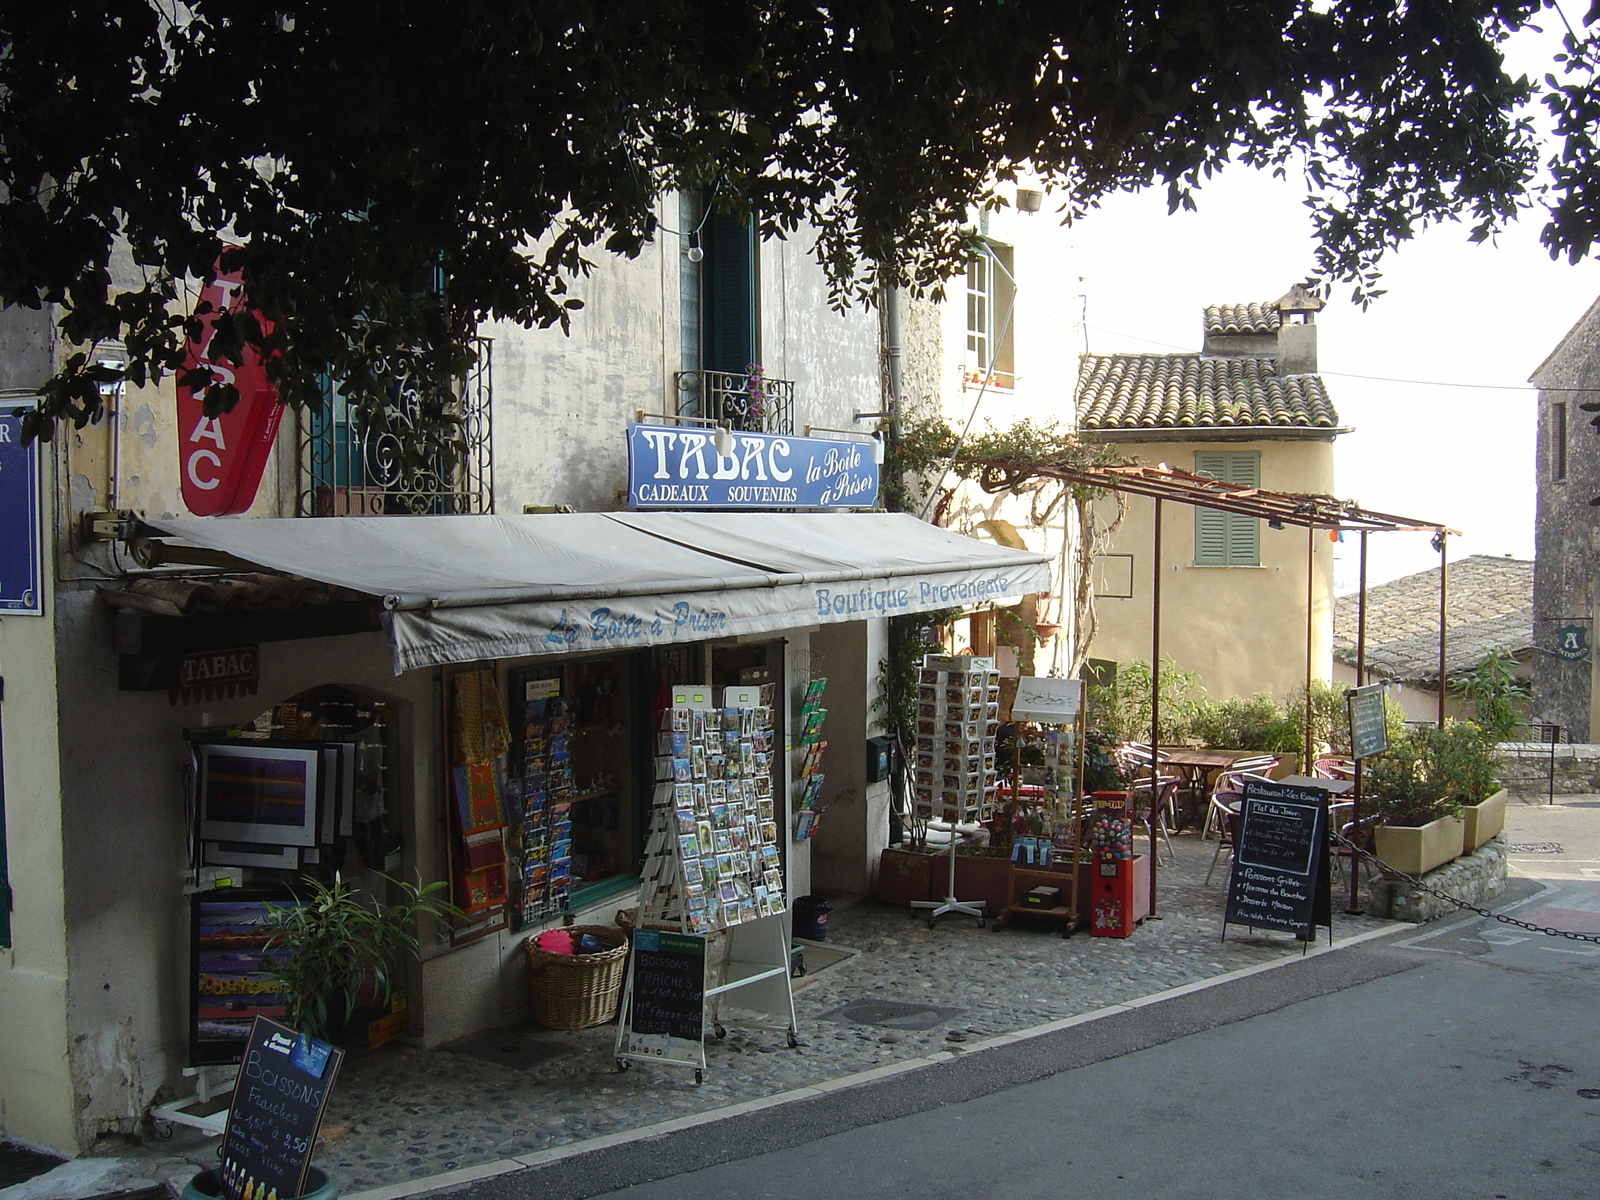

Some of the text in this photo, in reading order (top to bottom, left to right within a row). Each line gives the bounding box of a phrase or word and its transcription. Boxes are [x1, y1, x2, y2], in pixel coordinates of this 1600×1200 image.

[642, 430, 793, 482] TABAC
[639, 484, 798, 503] CADEAUX SOUVENIRS
[815, 587, 909, 617] Boutique
[651, 608, 664, 637] à
[672, 600, 727, 637] Priser
[1564, 632, 1579, 649] A
[184, 653, 252, 681] TABAC
[1252, 802, 1268, 813] Plat
[1269, 806, 1279, 815] du
[1244, 867, 1276, 884] Poissons
[1269, 887, 1279, 896] du
[641, 954, 689, 970] BOISSONS
